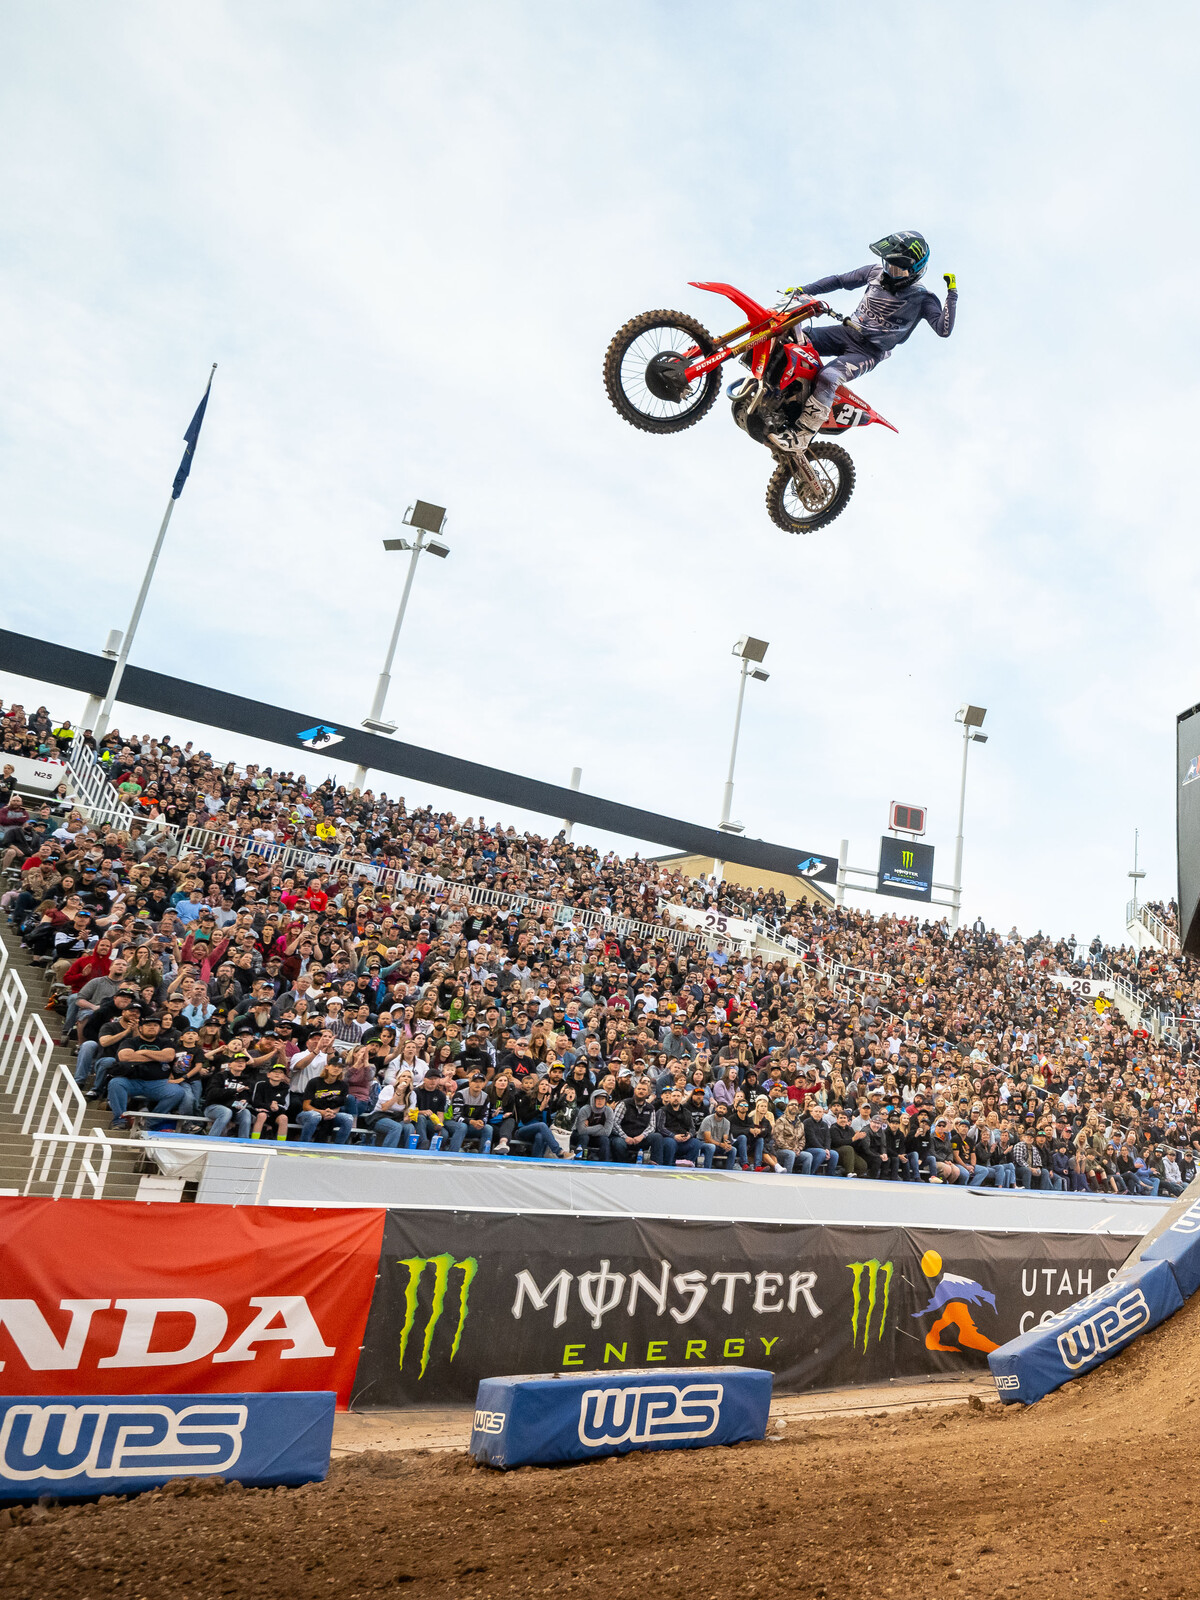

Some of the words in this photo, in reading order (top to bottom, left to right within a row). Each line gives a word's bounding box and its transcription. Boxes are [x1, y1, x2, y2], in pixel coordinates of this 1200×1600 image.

[860, 304, 899, 329] HONDA
[696, 351, 727, 371] DUNLOP
[34, 771, 53, 780] N25
[705, 915, 727, 933] 25
[1072, 980, 1091, 994] 26
[1021, 1268, 1092, 1297] UTAH
[1057, 1288, 1150, 1370] WPS
[562, 1336, 780, 1366] ENERGY
[994, 1375, 1020, 1390] WPS
[474, 1410, 506, 1435] WPS
[578, 1384, 724, 1448] WPS
[0, 1404, 248, 1481] WPS
